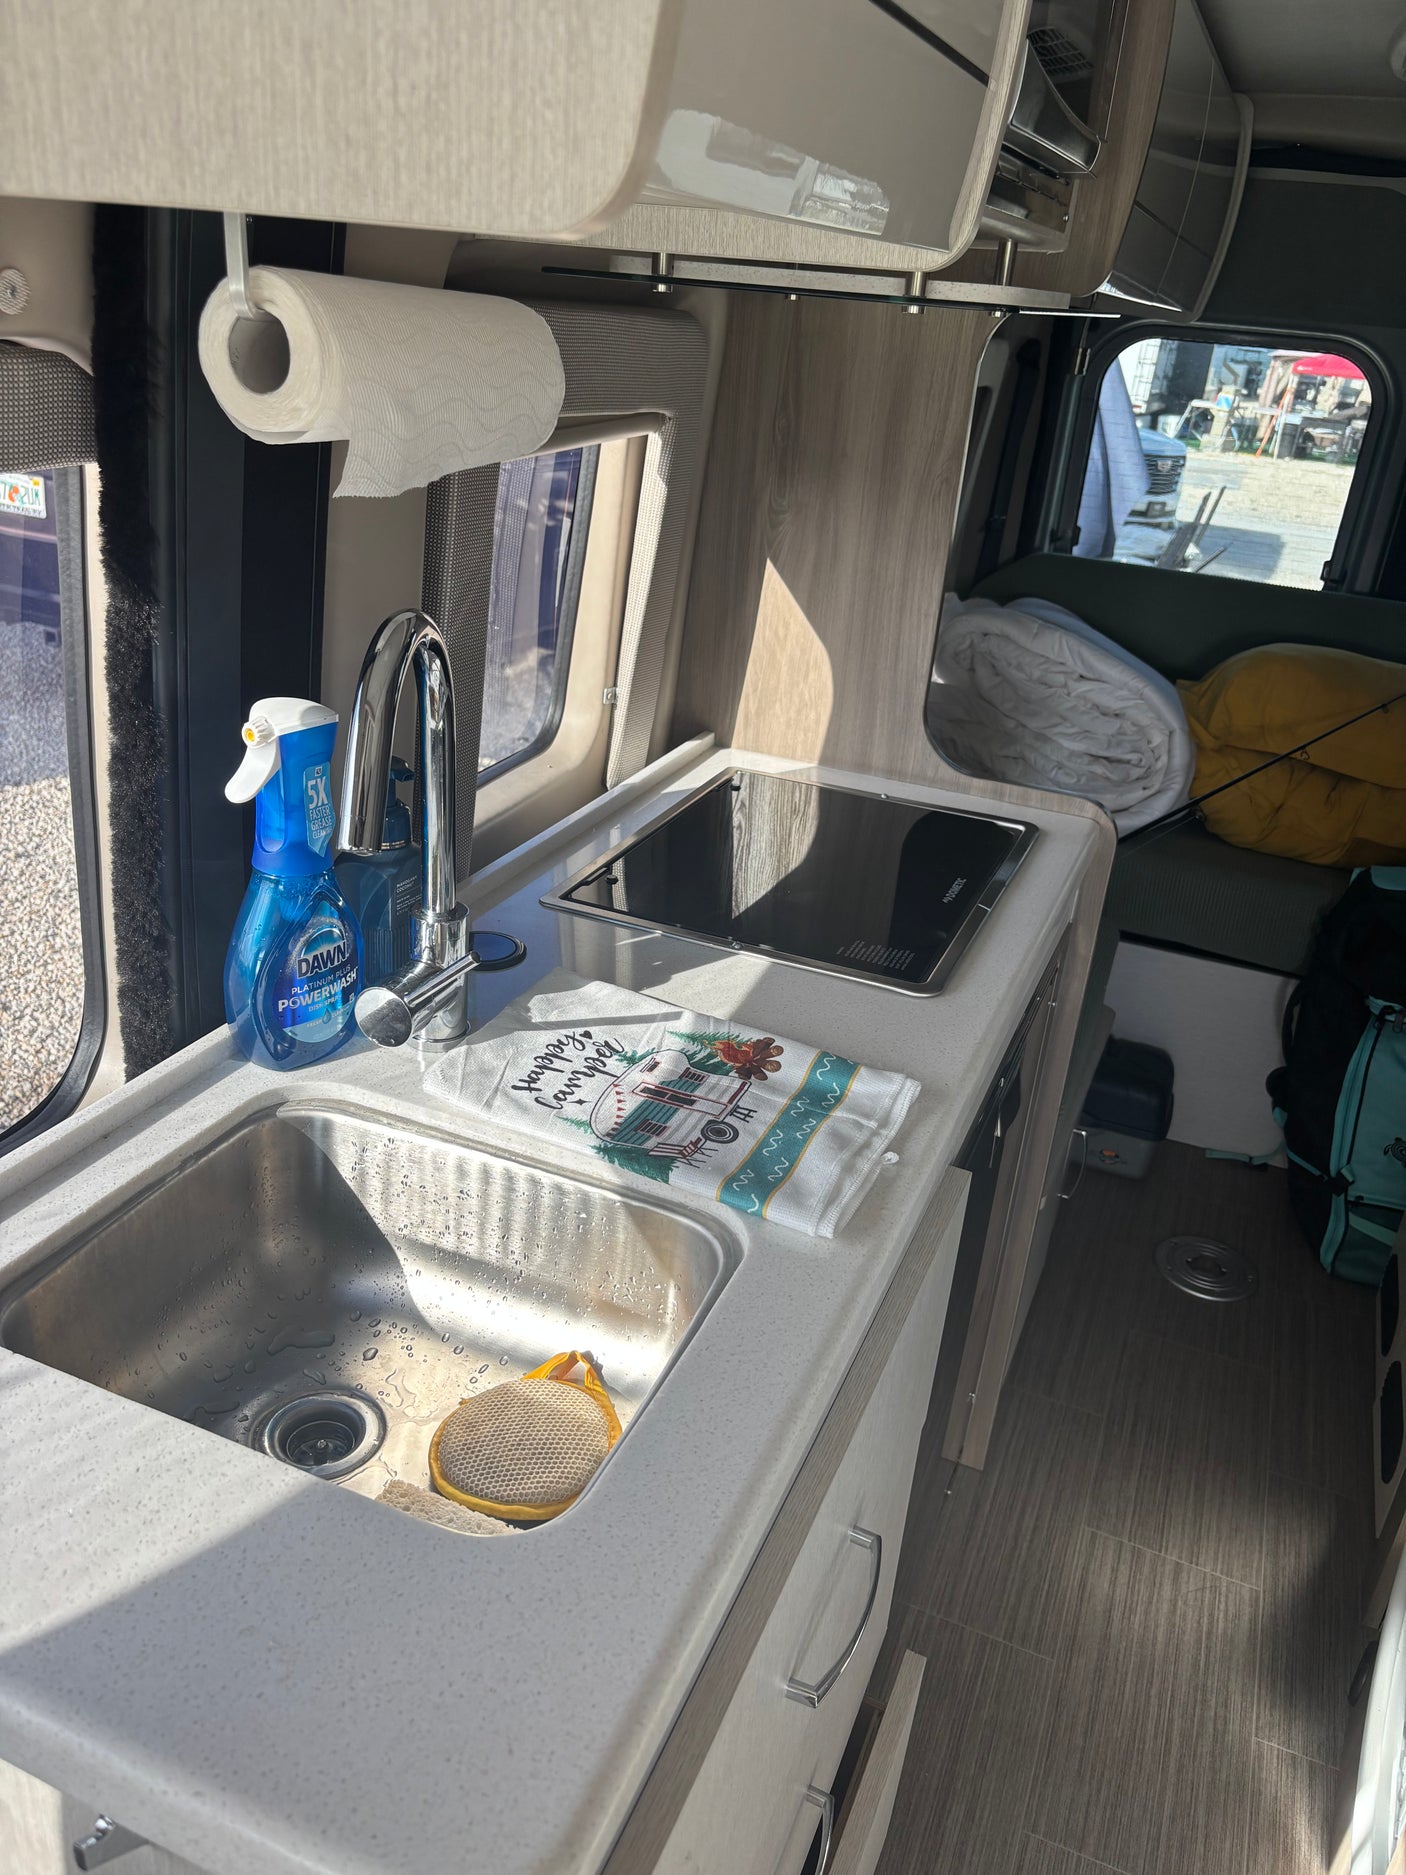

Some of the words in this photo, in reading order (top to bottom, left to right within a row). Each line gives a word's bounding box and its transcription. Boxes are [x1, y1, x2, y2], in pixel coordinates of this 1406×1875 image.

[307, 775, 329, 809] 5X
[309, 804, 331, 821] FASTER
[311, 815, 332, 831] GREASE
[297, 941, 347, 979] DAWN
[278, 967, 357, 1013] POWERWASH
[291, 973, 334, 995] PLATINUM
[335, 964, 351, 979] PLUS
[511, 1031, 586, 1093] Happy
[534, 1038, 625, 1110] Camper
